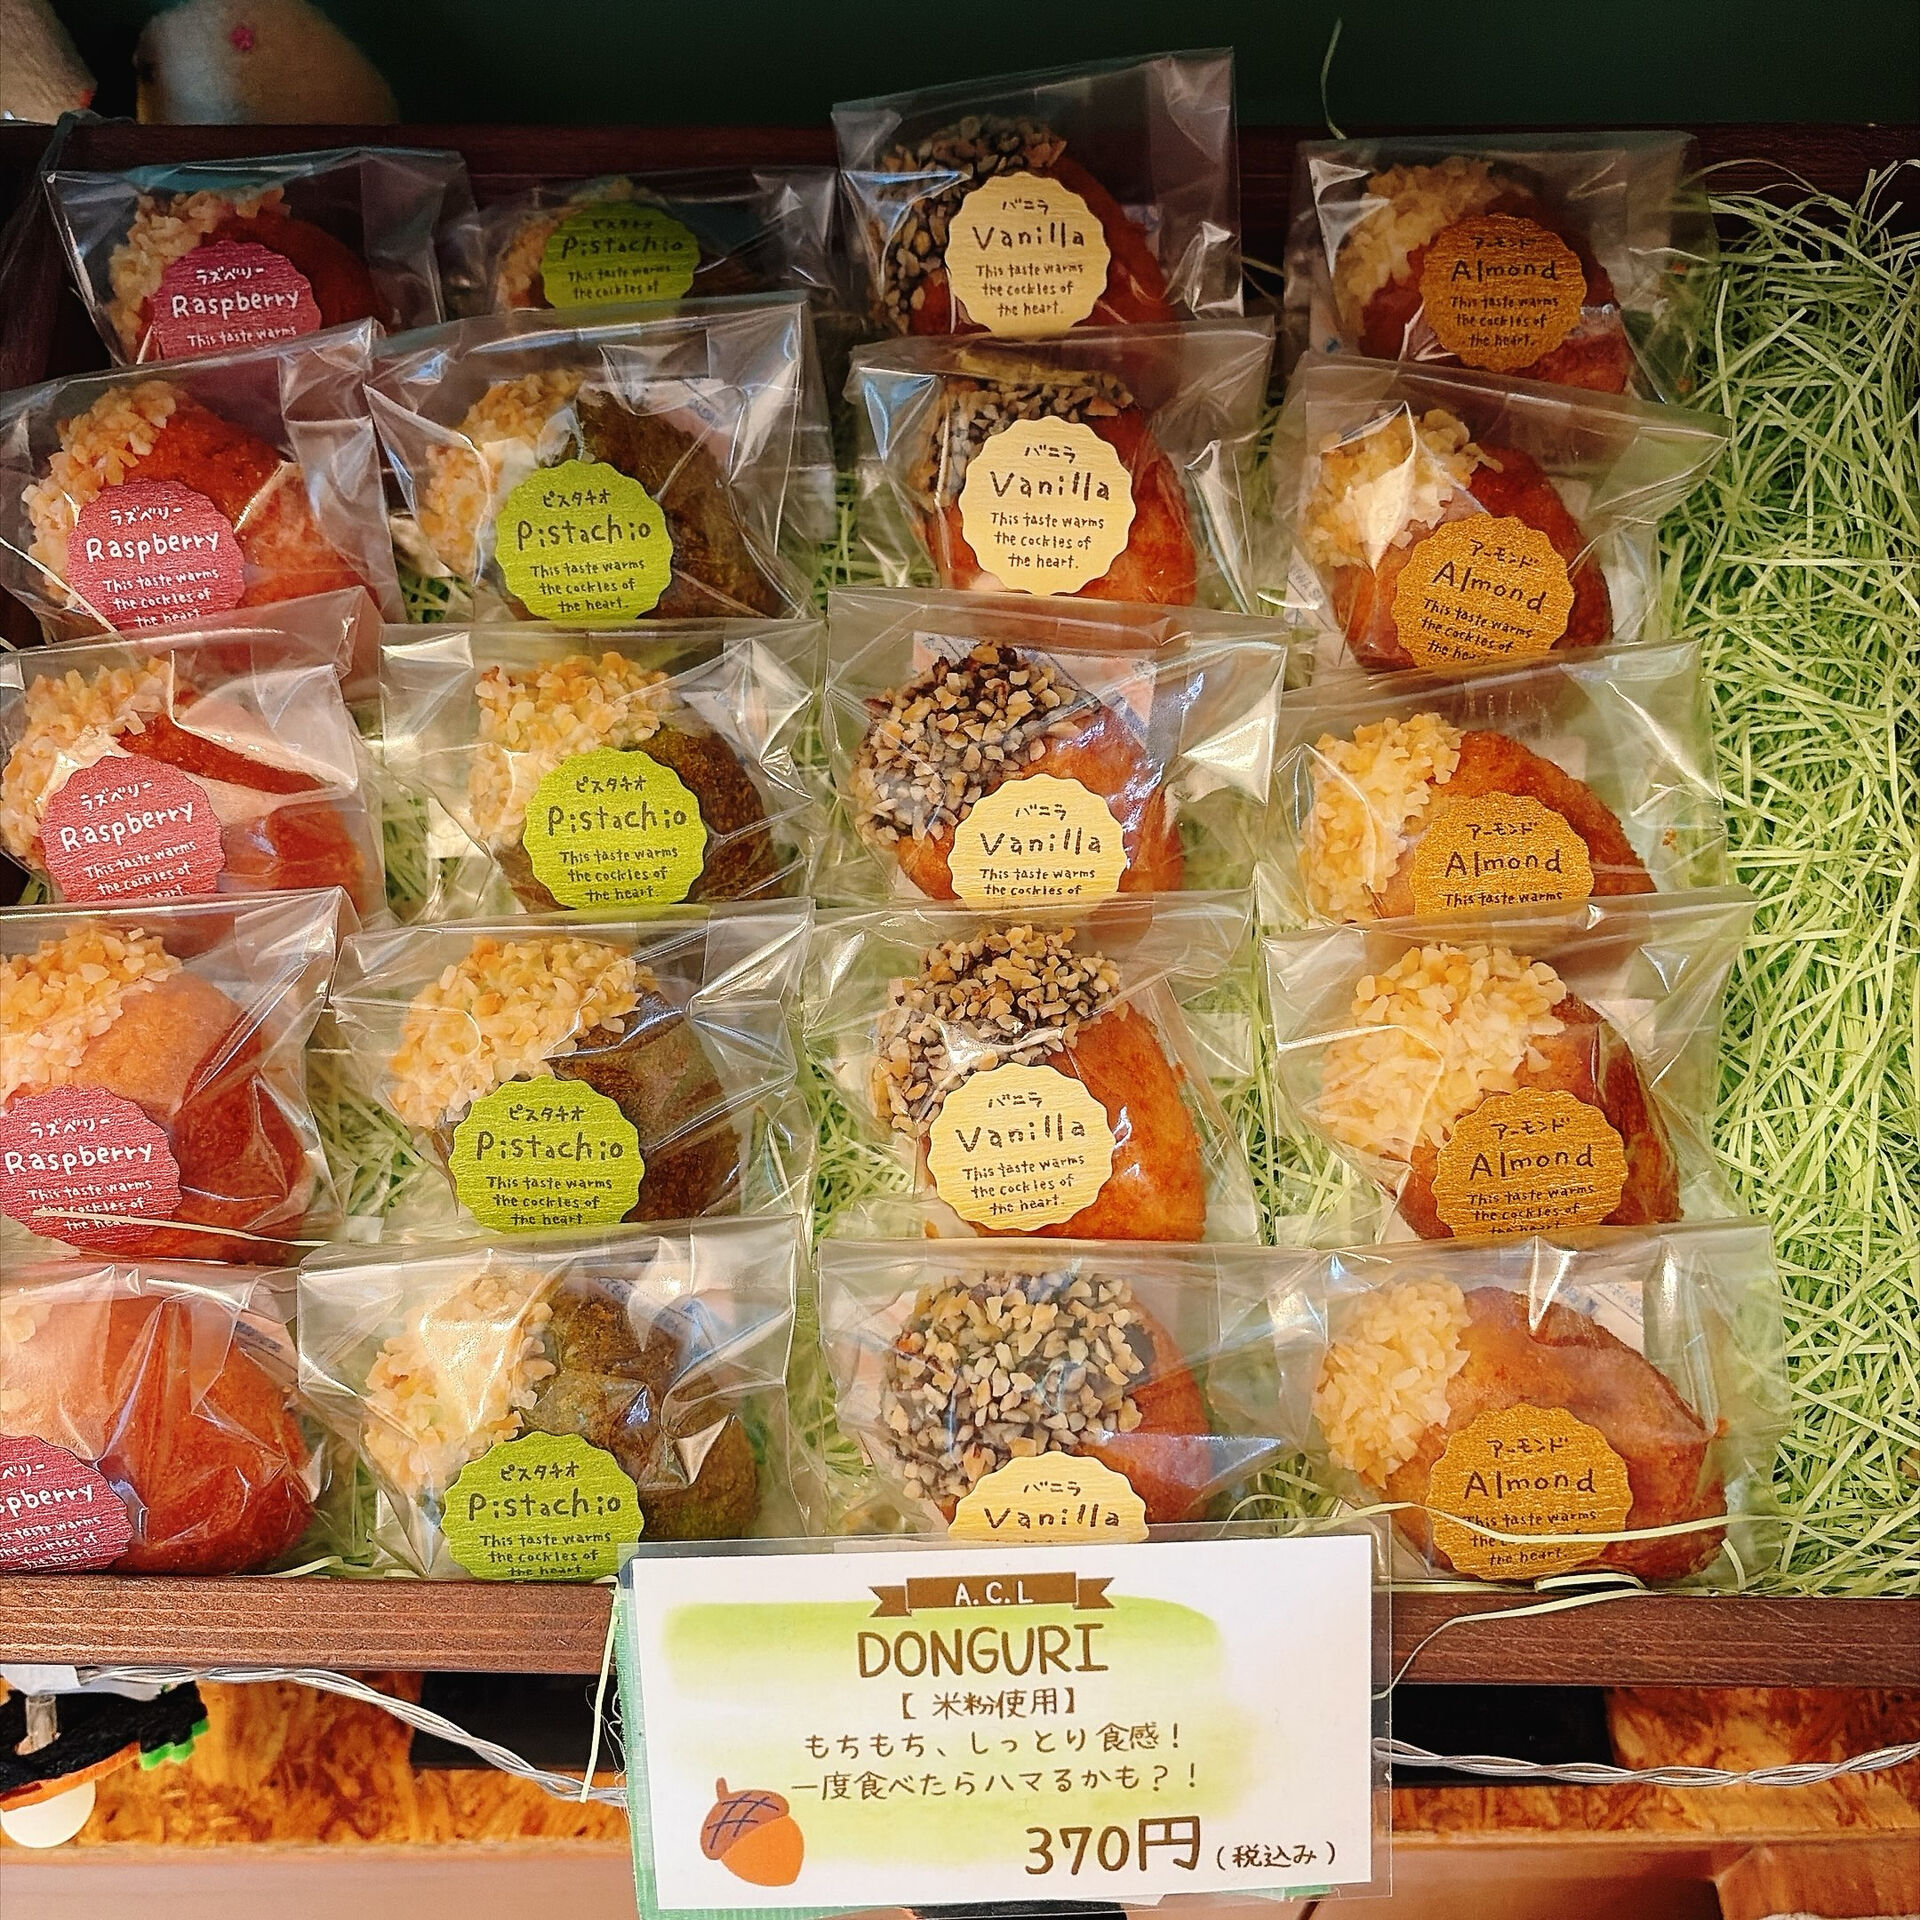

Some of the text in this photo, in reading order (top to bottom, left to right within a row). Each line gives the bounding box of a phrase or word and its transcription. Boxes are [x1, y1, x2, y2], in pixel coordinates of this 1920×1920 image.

[1002, 198, 1048, 214] バニラ
[972, 222, 1084, 250] Vanilla
[562, 235, 683, 259] Pistachio
[196, 266, 265, 285] ラズベリー
[976, 263, 1083, 278] This taste warms
[1451, 260, 1557, 282] Almond
[982, 281, 1073, 296] the cockles of
[172, 291, 299, 320] Raspberry
[998, 301, 1064, 317] the heart.
[187, 327, 296, 347] This taste warms
[1025, 445, 1075, 463] バニラ
[990, 472, 1109, 501] Vanilla
[543, 488, 610, 507] ピスタチオ
[110, 506, 182, 526] ラズベリー
[991, 512, 1104, 529] This taste warms
[518, 514, 650, 551] Pistachio
[994, 531, 1091, 550] the cockles of
[86, 532, 219, 564] Raspberry
[1470, 538, 1538, 568] アーモンド
[530, 560, 644, 578] This taste warms
[1008, 553, 1078, 568] the heart.
[103, 569, 219, 593] This taste warms
[539, 578, 635, 595] the cockles of
[1432, 561, 1546, 614] Almond
[113, 588, 211, 610] the cockles of
[558, 597, 628, 613] the heart.
[134, 616, 157, 628] the
[1424, 598, 1532, 638] This taste warms
[1421, 617, 1441, 633] the
[1499, 641, 1513, 653] of
[1428, 640, 1448, 655] the
[575, 775, 646, 793] ピスタチオ
[80, 780, 153, 810] ラズベリー
[548, 800, 686, 836] Pistachio
[1015, 804, 1066, 820] バニラ
[60, 802, 192, 853] Raspberry
[1466, 822, 1538, 840] アーモンド
[980, 827, 1101, 855] Vanilla
[83, 841, 196, 879] This taste warms
[560, 847, 678, 865] This taste warms
[1445, 850, 1562, 878] Almond
[97, 862, 192, 896] the cockles of
[568, 865, 668, 882] the cockles of
[980, 868, 1095, 880] This taste warms
[586, 886, 659, 902] the heart.
[984, 884, 1082, 895] the cockles of
[1443, 892, 1562, 907] This taste warms
[988, 1092, 1042, 1108] バニラ
[509, 1104, 584, 1121] ピスタチオ
[30, 1117, 110, 1139] ラズベリー
[956, 1113, 1085, 1152] Vanilla
[1491, 1117, 1570, 1139] アーモンド
[477, 1131, 623, 1161] Pistachio
[5, 1143, 152, 1175] Raspberry
[962, 1156, 1084, 1181] This taste warms
[1469, 1144, 1594, 1180] Almond
[28, 1180, 152, 1202] This taste warms
[486, 1176, 612, 1190] This taste warms
[971, 1174, 1074, 1198] the cockles of
[131, 1197, 144, 1209] of
[493, 1194, 600, 1209] the cockles of
[989, 1194, 1064, 1215] the heart.
[1466, 1185, 1594, 1205] This taste warms
[511, 1214, 589, 1225] the heart.
[1475, 1210, 1501, 1220] the
[1562, 1203, 1580, 1214] of
[64, 1220, 89, 1232] the
[1487, 1437, 1568, 1458] アーモンド
[500, 1461, 579, 1482] ピスタチオ
[1024, 1481, 1081, 1496] バニラ
[1464, 1468, 1596, 1500] Almond
[469, 1488, 621, 1521] Pistachio
[984, 1503, 1119, 1529] Vanilla
[1502, 1511, 1596, 1527] taste warms
[480, 1532, 611, 1547] This taste warms
[1469, 1536, 1495, 1547] the
[488, 1550, 598, 1563] the cockles of
[1489, 1554, 1512, 1566] the
[955, 1581, 1033, 1607] A.C.L
[857, 1622, 1109, 1679] DONGURI
[1025, 1815, 1202, 1874] 370円
